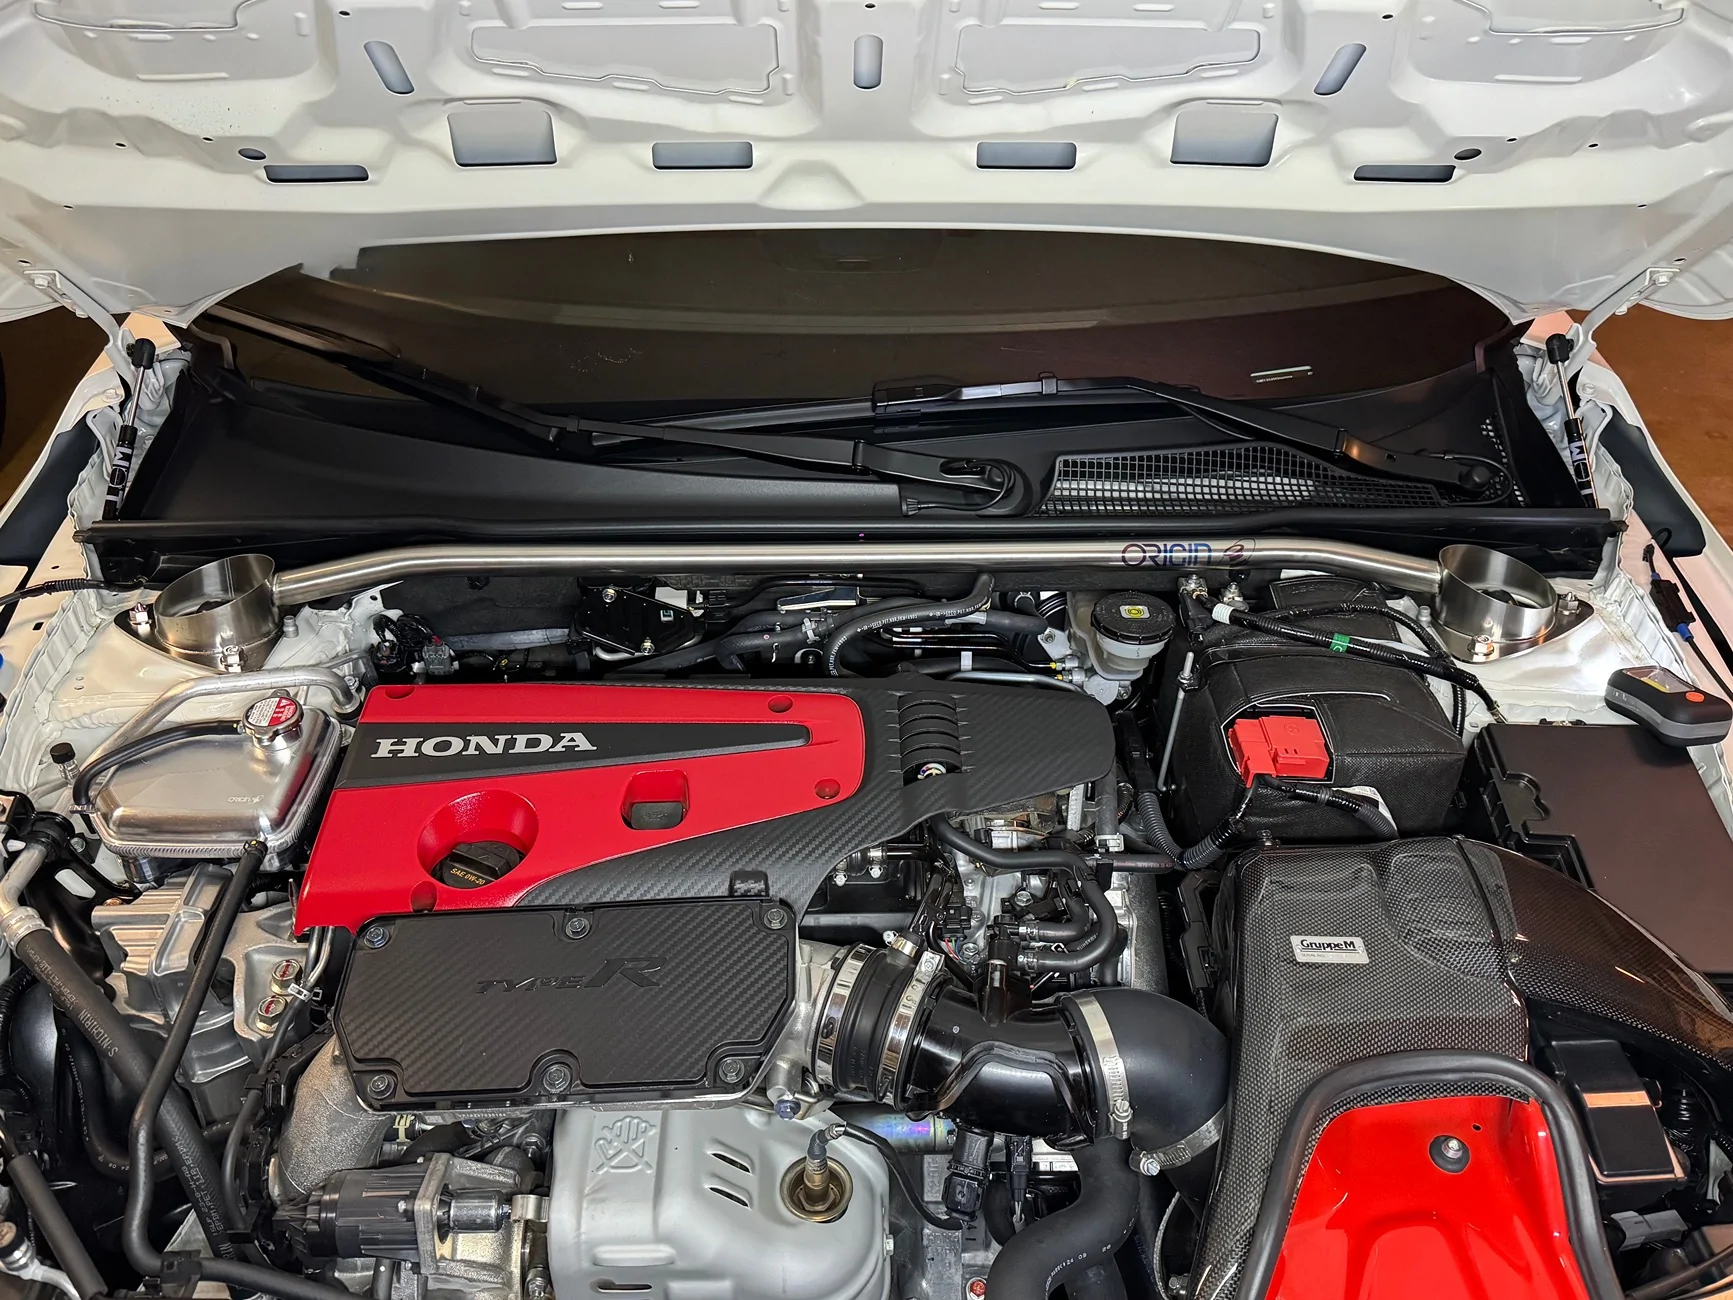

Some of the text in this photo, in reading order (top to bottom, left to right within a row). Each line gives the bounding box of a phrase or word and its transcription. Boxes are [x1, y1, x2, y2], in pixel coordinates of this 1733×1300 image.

[371, 732, 597, 758] HONDA
[450, 868, 467, 878] SAE
[1300, 939, 1356, 951] GruppeM
[476, 957, 668, 994] TYPE R
